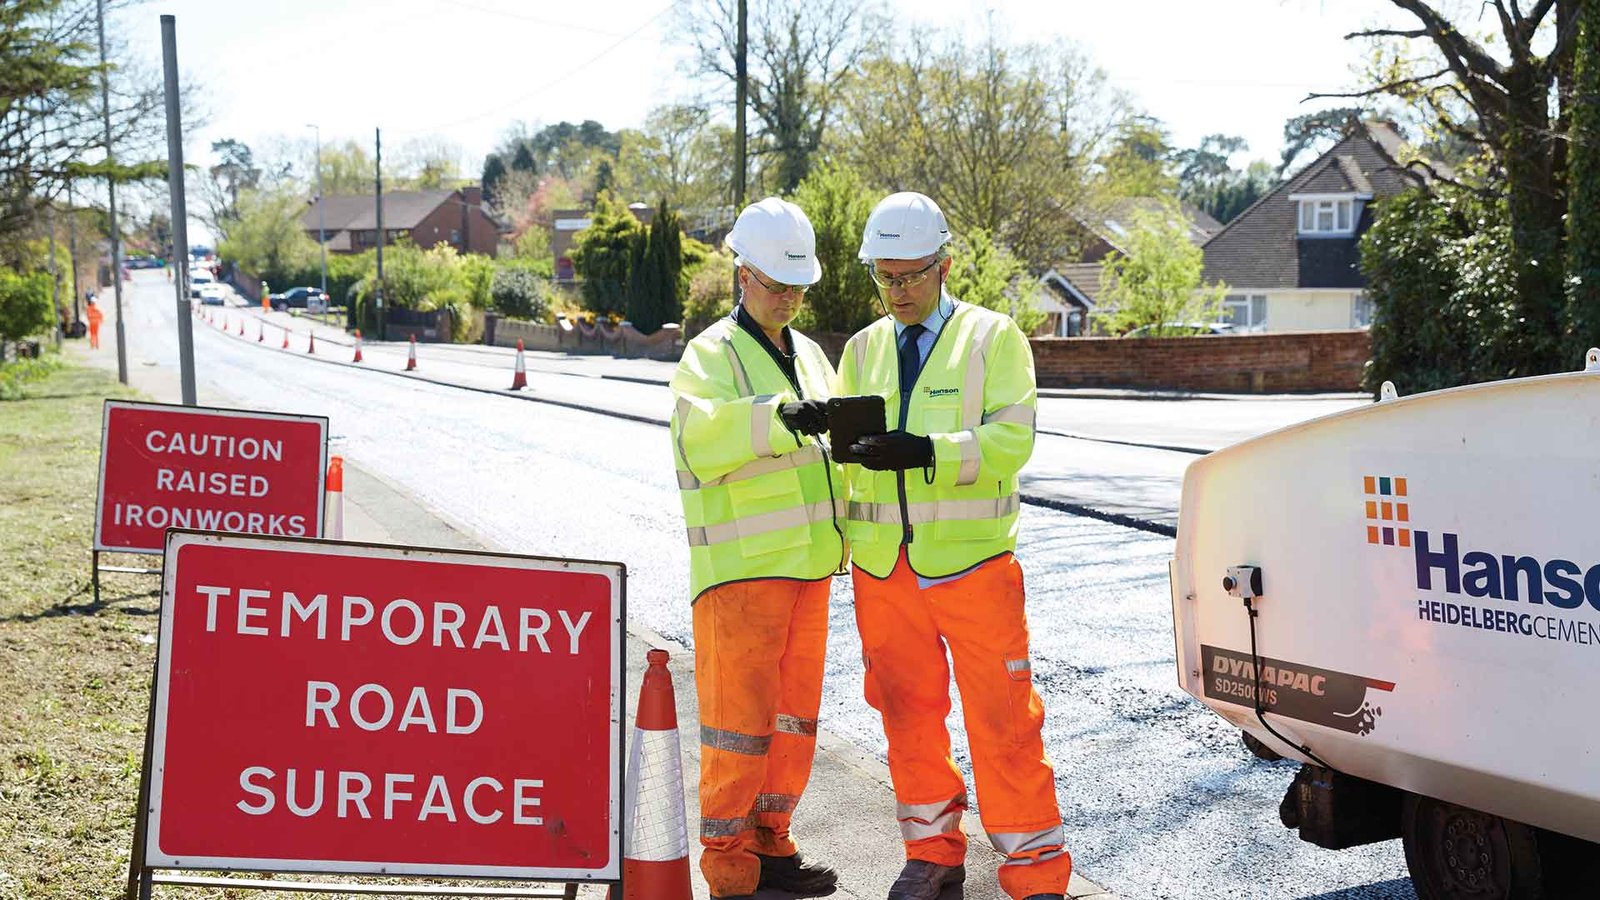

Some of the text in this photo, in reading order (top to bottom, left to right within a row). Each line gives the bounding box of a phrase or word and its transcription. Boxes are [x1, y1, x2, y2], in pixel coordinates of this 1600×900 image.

[929, 387, 959, 395] Hanson
[145, 430, 283, 462] CAUTION
[156, 468, 269, 497] RAISED
[114, 503, 306, 537] IRONWORKS
[196, 585, 593, 655] TEMPORARY
[1212, 655, 1326, 696] DYNAPAC
[305, 680, 484, 735] ROAD
[236, 766, 544, 826] SURFACE
